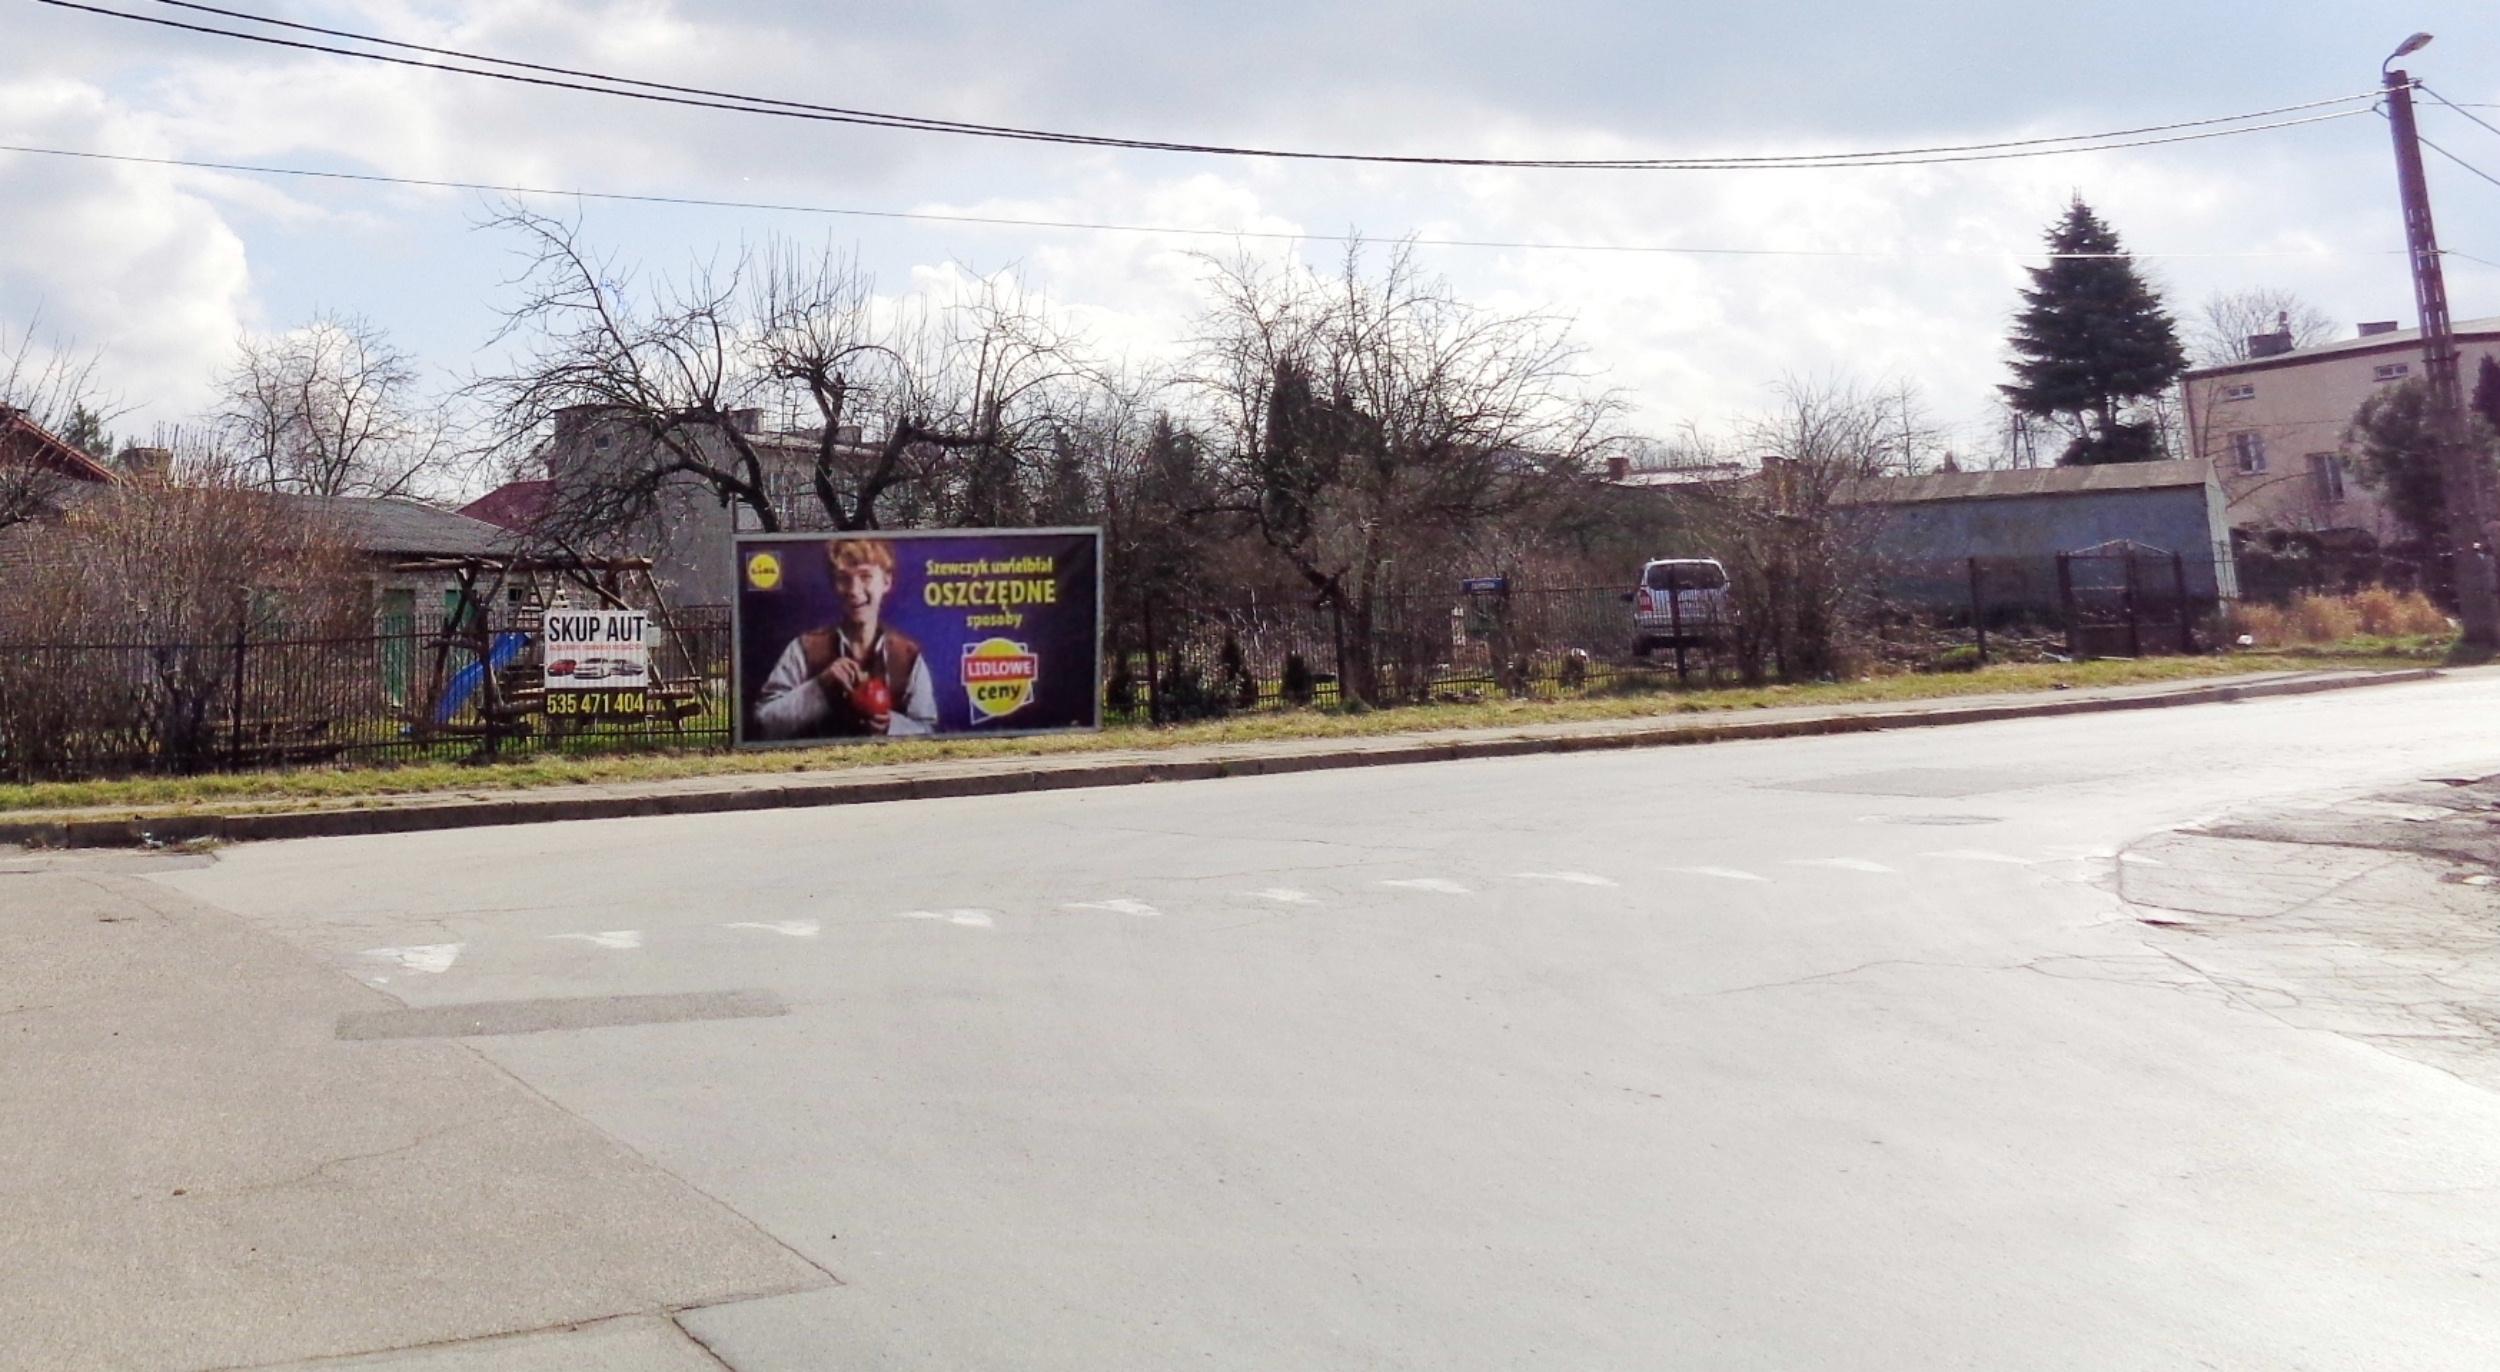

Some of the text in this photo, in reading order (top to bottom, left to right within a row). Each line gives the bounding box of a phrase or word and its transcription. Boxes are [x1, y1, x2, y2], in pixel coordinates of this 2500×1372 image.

[924, 580, 1056, 609] OSZCZĘDNE
[548, 616, 644, 642] SKUP AUT
[966, 611, 1022, 630] sposoby
[968, 660, 1032, 676] LIDLOWE
[977, 684, 1021, 701] ceny
[547, 693, 644, 713] 535 471 404
